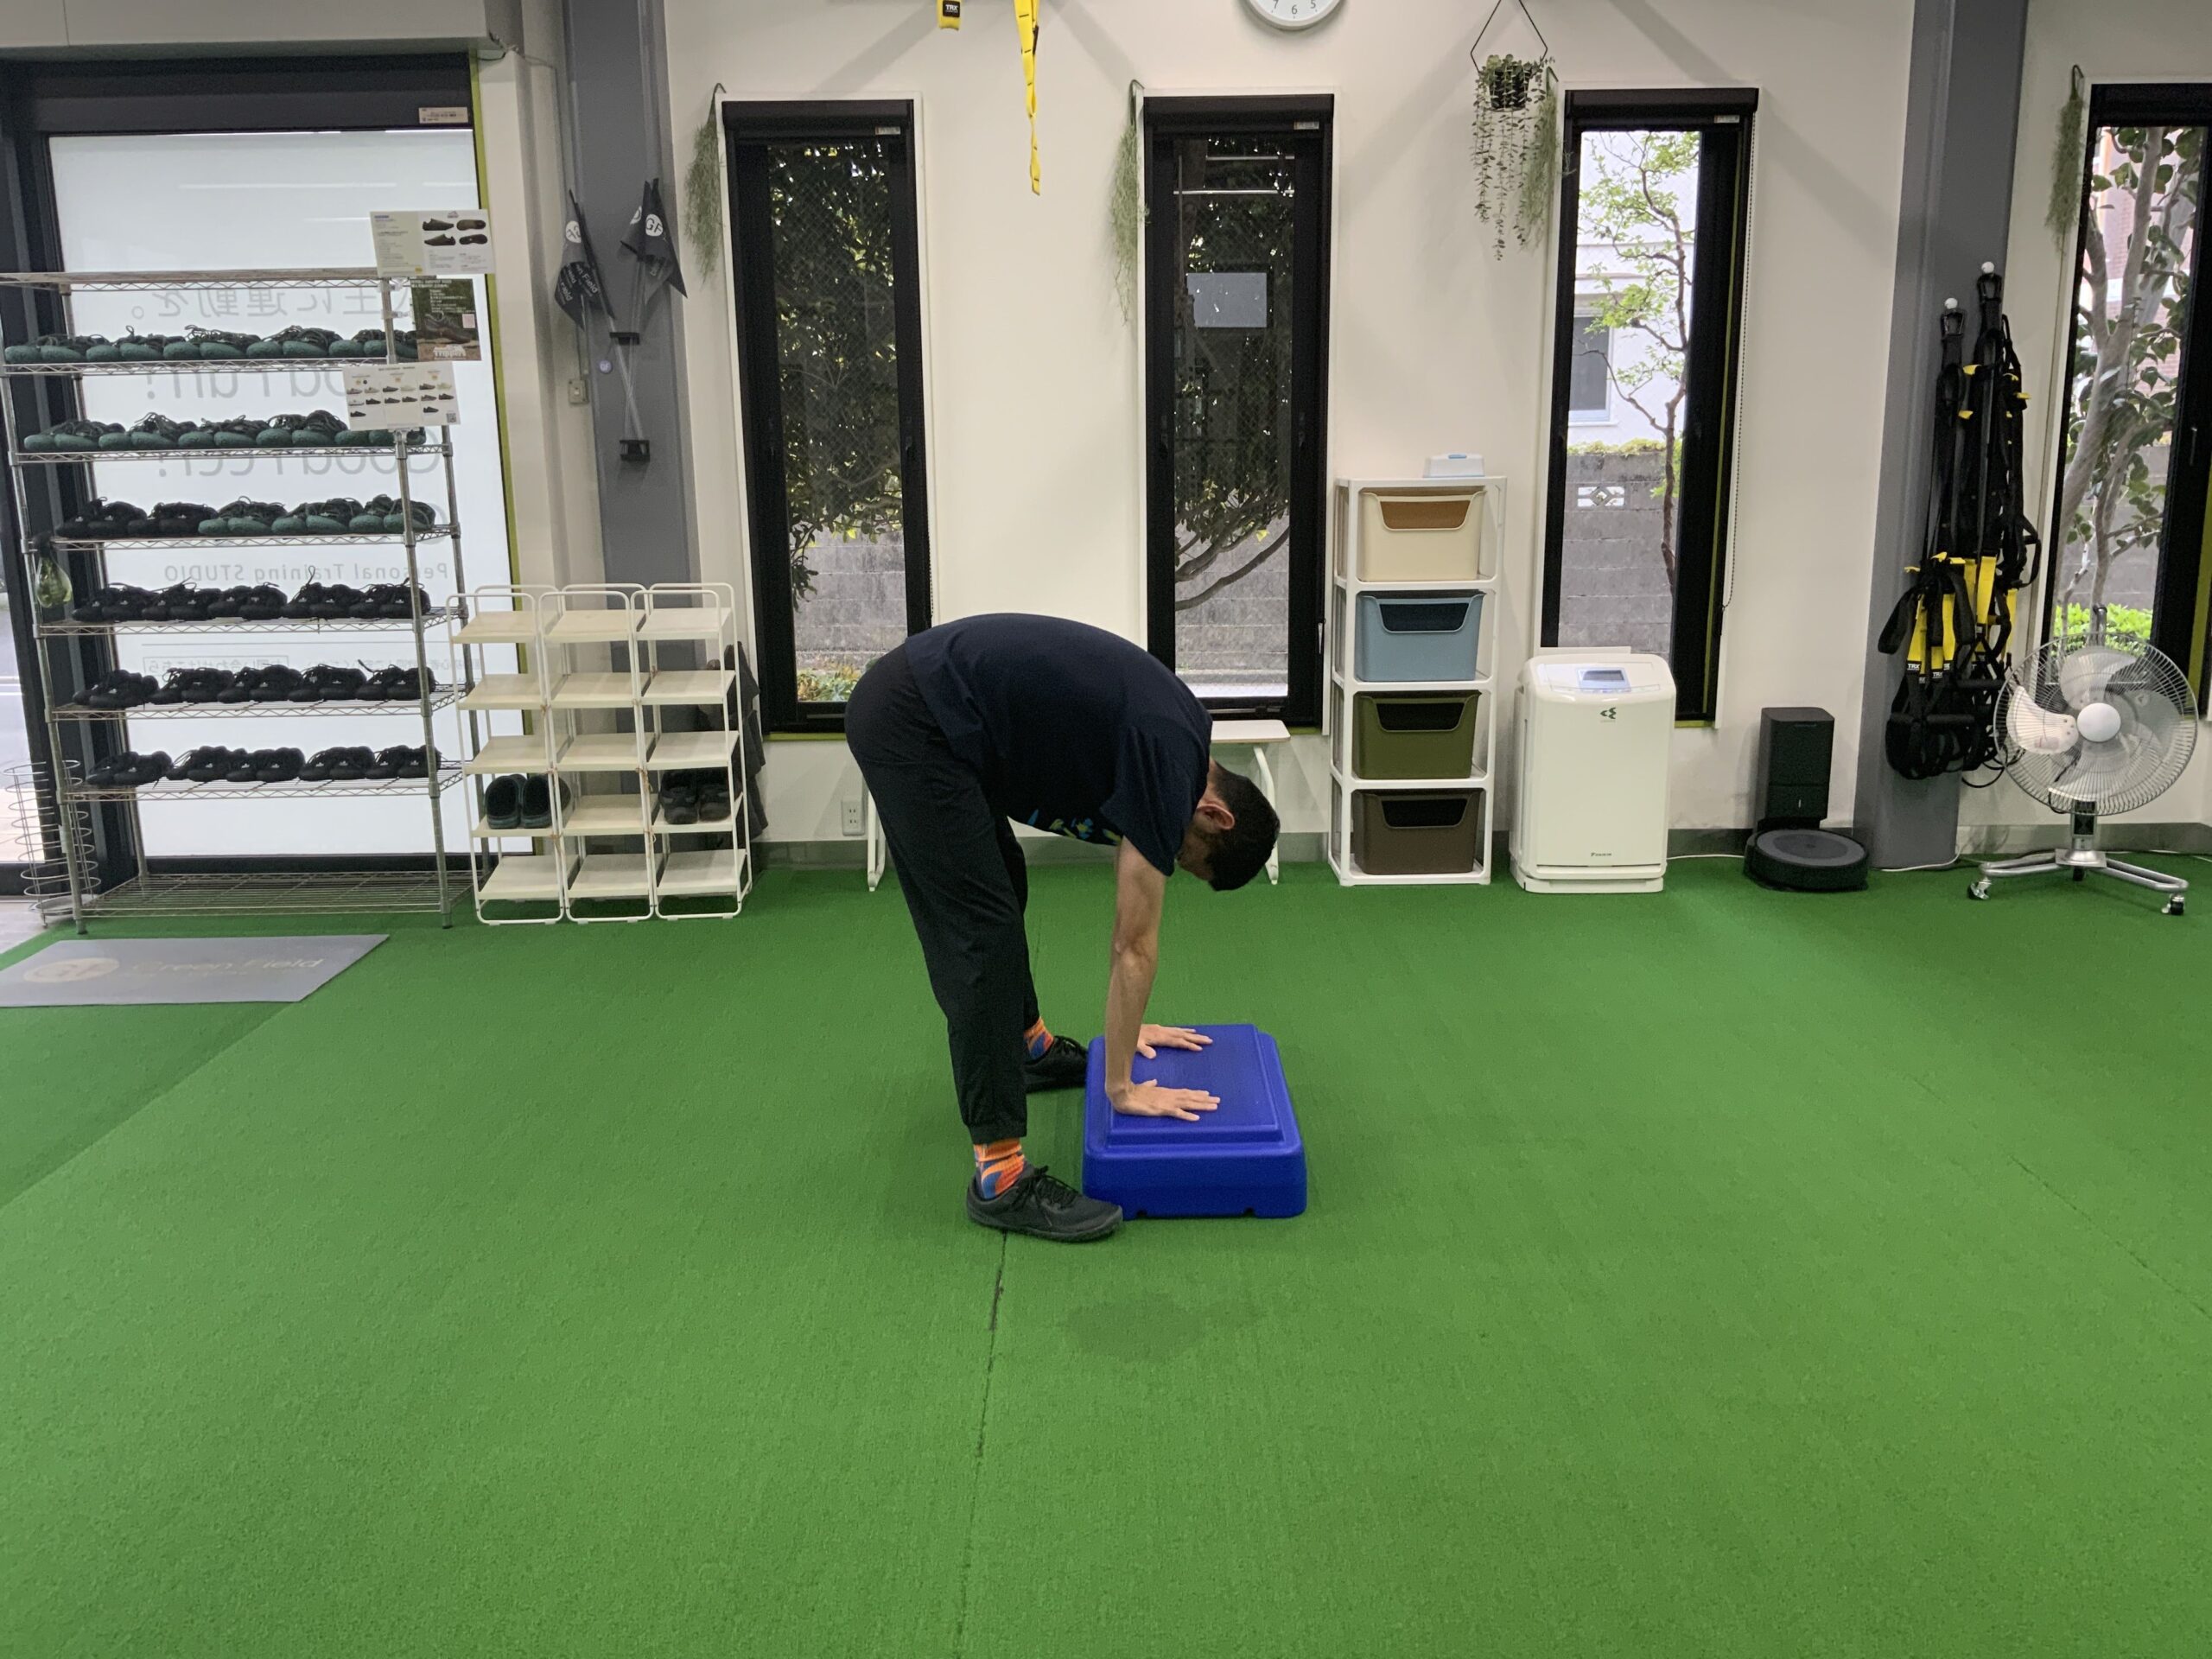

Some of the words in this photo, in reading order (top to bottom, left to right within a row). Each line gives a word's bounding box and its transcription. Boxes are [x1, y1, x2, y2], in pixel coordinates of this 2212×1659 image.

[1273, 0, 1278, 9] 7
[1291, 4, 1298, 15] 6
[1310, 0, 1316, 9] 5
[646, 218, 662, 232] GF
[244, 957, 324, 969] Field
